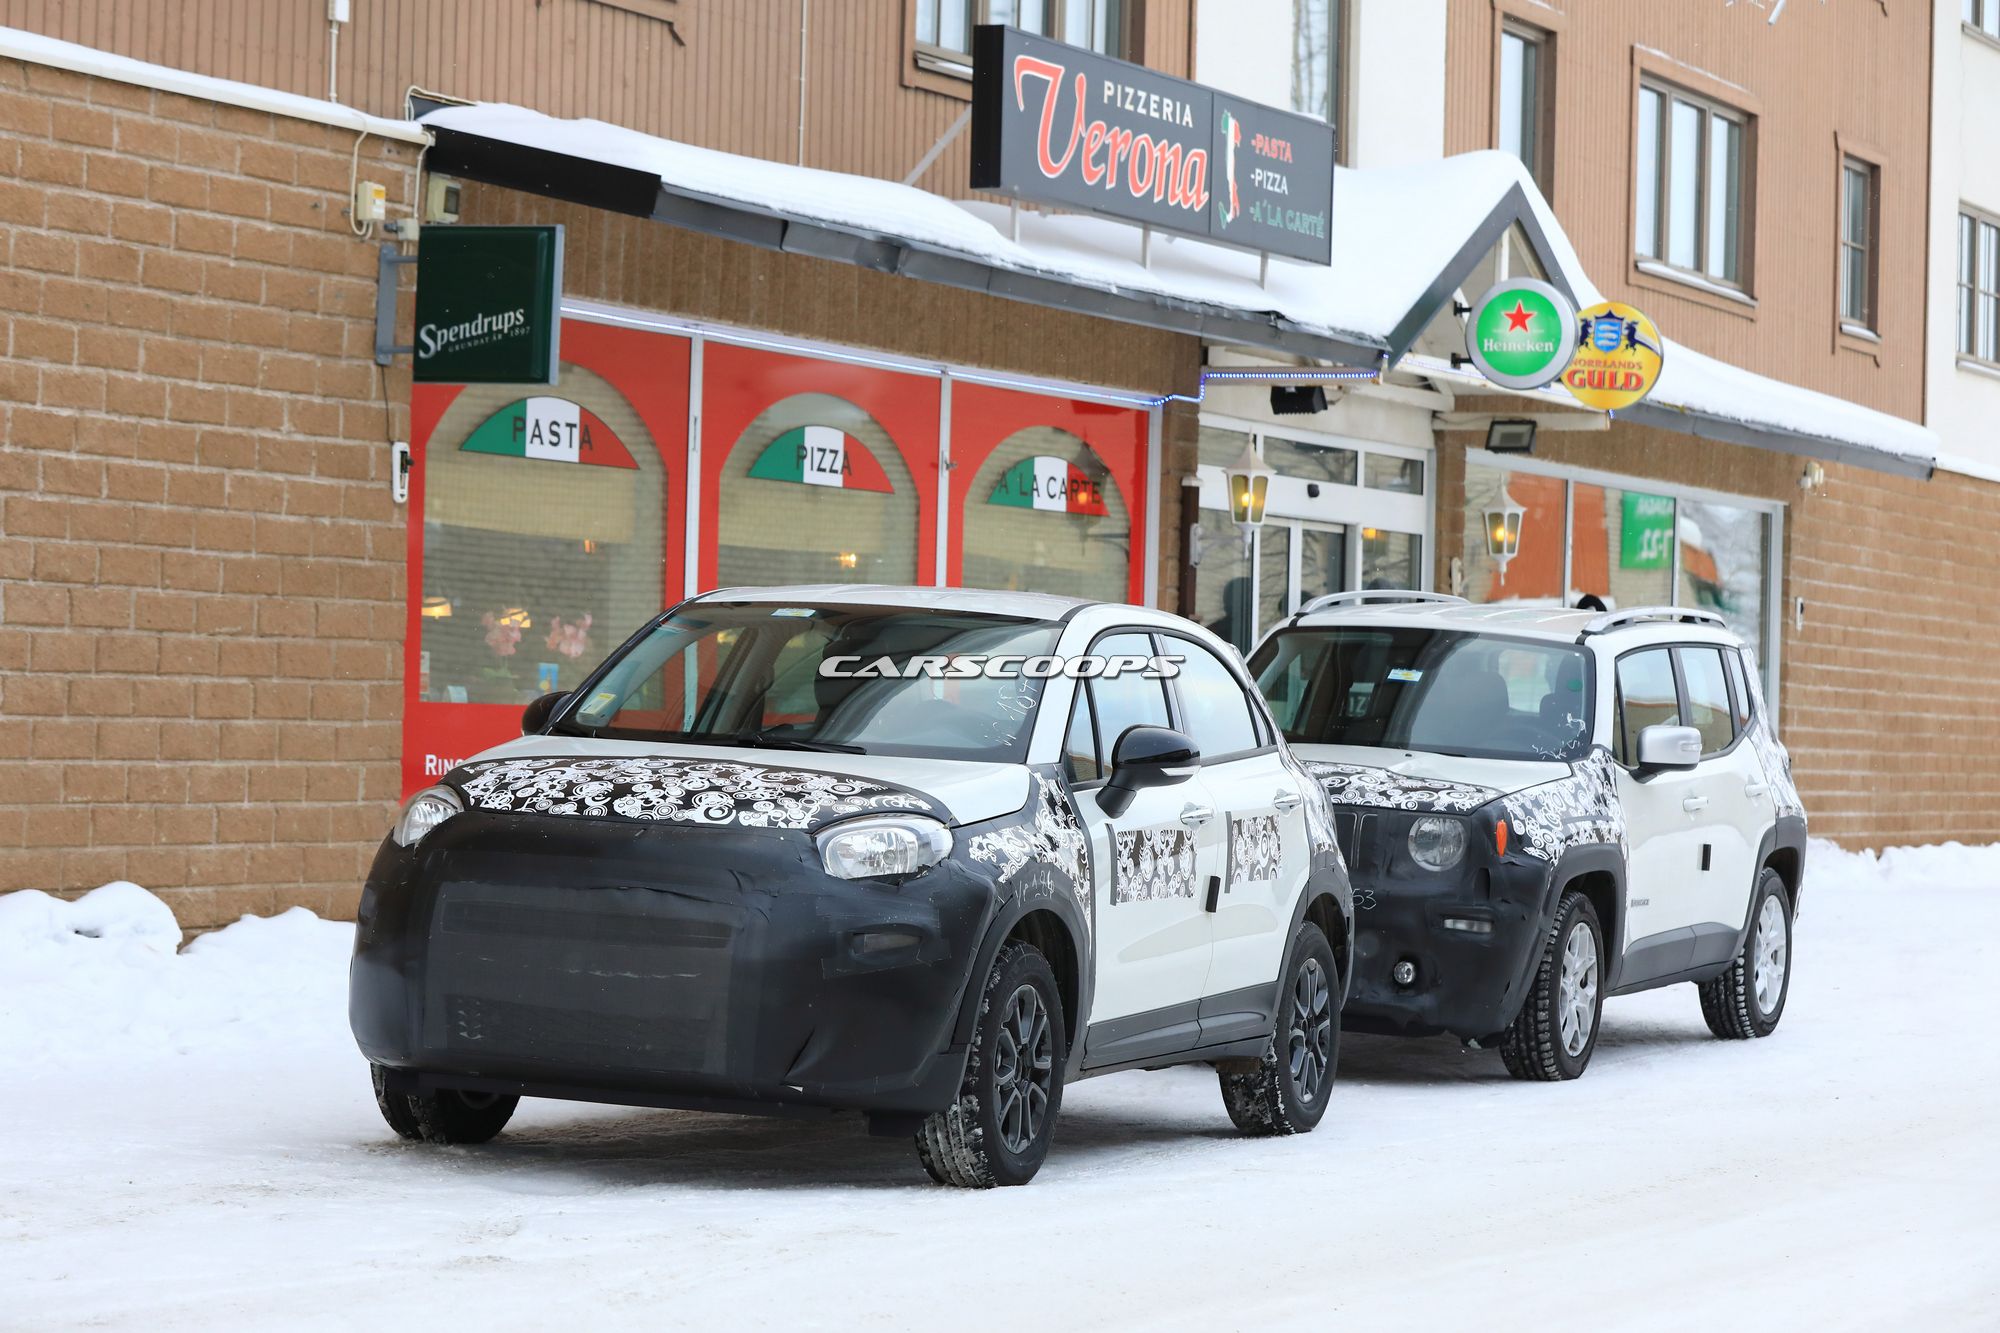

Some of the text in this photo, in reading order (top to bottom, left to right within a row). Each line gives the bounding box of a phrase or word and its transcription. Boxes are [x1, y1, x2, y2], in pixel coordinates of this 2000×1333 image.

[1103, 80, 1193, 128] PIZZERIA
[1014, 54, 1209, 212] Verona
[418, 308, 525, 358] Spendrups
[1483, 338, 1555, 353] Heineken
[1567, 368, 1644, 392] GULD
[512, 416, 593, 450] PASTA
[796, 444, 852, 476] PIZZA
[1019, 473, 1041, 498] LA
[1046, 476, 1101, 504] CARTE
